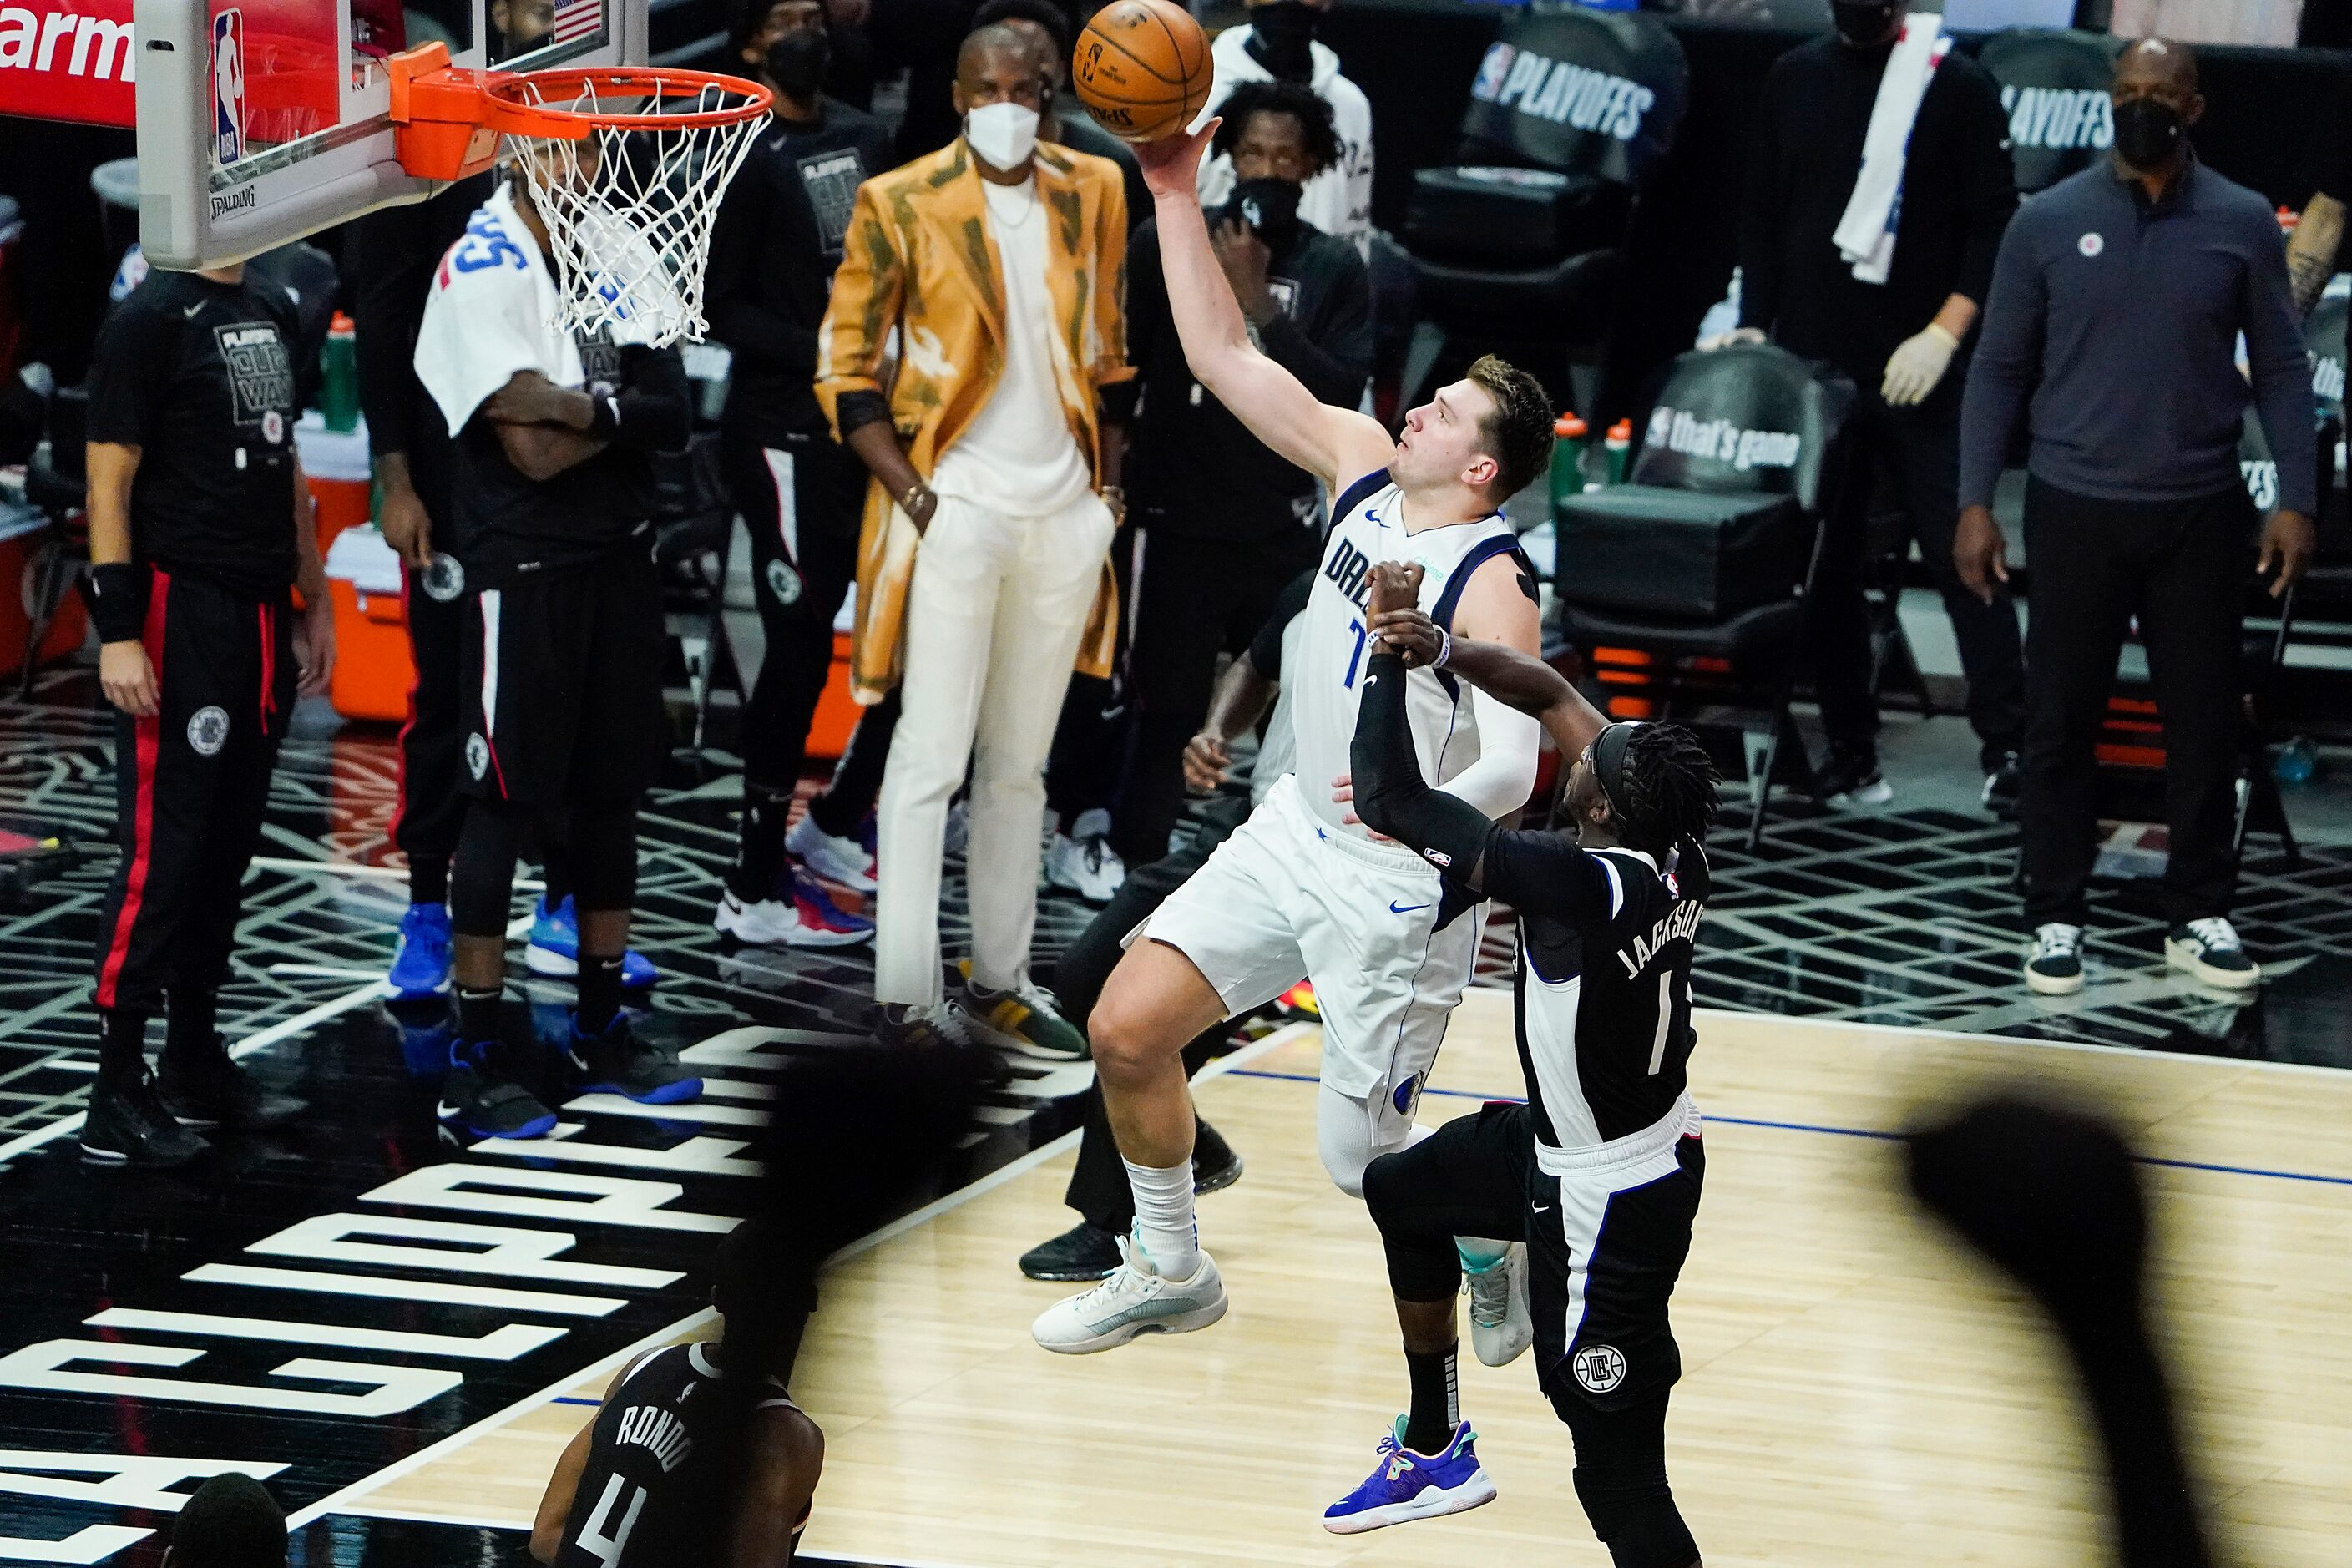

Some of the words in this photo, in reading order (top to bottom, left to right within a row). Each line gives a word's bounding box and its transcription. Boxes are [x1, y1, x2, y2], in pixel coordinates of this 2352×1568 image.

[0, 7, 136, 83] arm
[1497, 50, 1656, 140] PLAYOFFS
[220, 130, 236, 159] NBA
[210, 184, 255, 220] SPALDING
[1669, 411, 1739, 462] that's
[1734, 429, 1800, 473] game
[1414, 554, 1444, 583] chime
[1616, 899, 1704, 981] JACKSON
[1648, 969, 1672, 1075] 1
[615, 1405, 695, 1474] RONDO
[575, 1471, 647, 1568] 4
